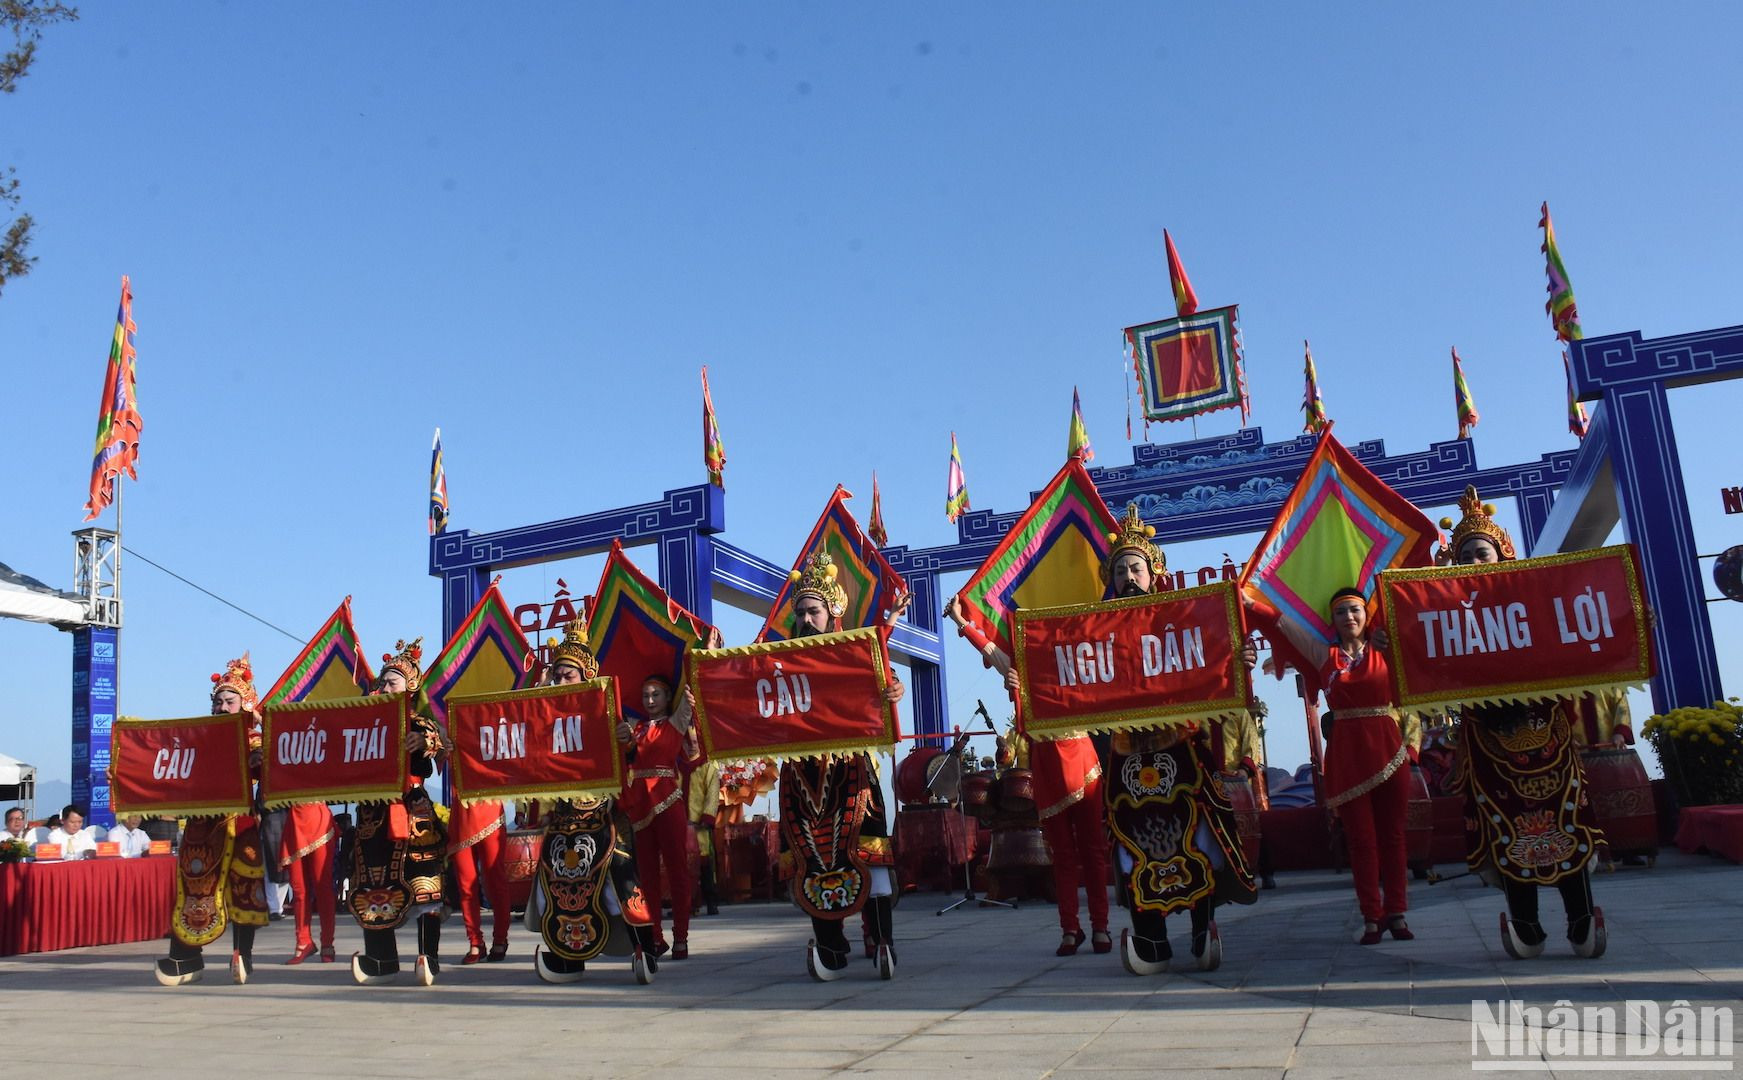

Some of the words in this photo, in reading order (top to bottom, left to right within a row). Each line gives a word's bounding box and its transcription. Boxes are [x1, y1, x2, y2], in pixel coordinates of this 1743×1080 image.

[1417, 591, 1533, 658] THẮNG
[1553, 585, 1614, 652] LỢI
[1054, 632, 1115, 687] NGƯ
[1141, 623, 1205, 677] DÂN
[756, 662, 811, 718] CẦU
[153, 737, 195, 780] CẦU
[278, 717, 327, 765] QUỐC
[343, 718, 387, 763] THÁI
[480, 717, 526, 761] DÂN
[552, 715, 583, 754] AN
